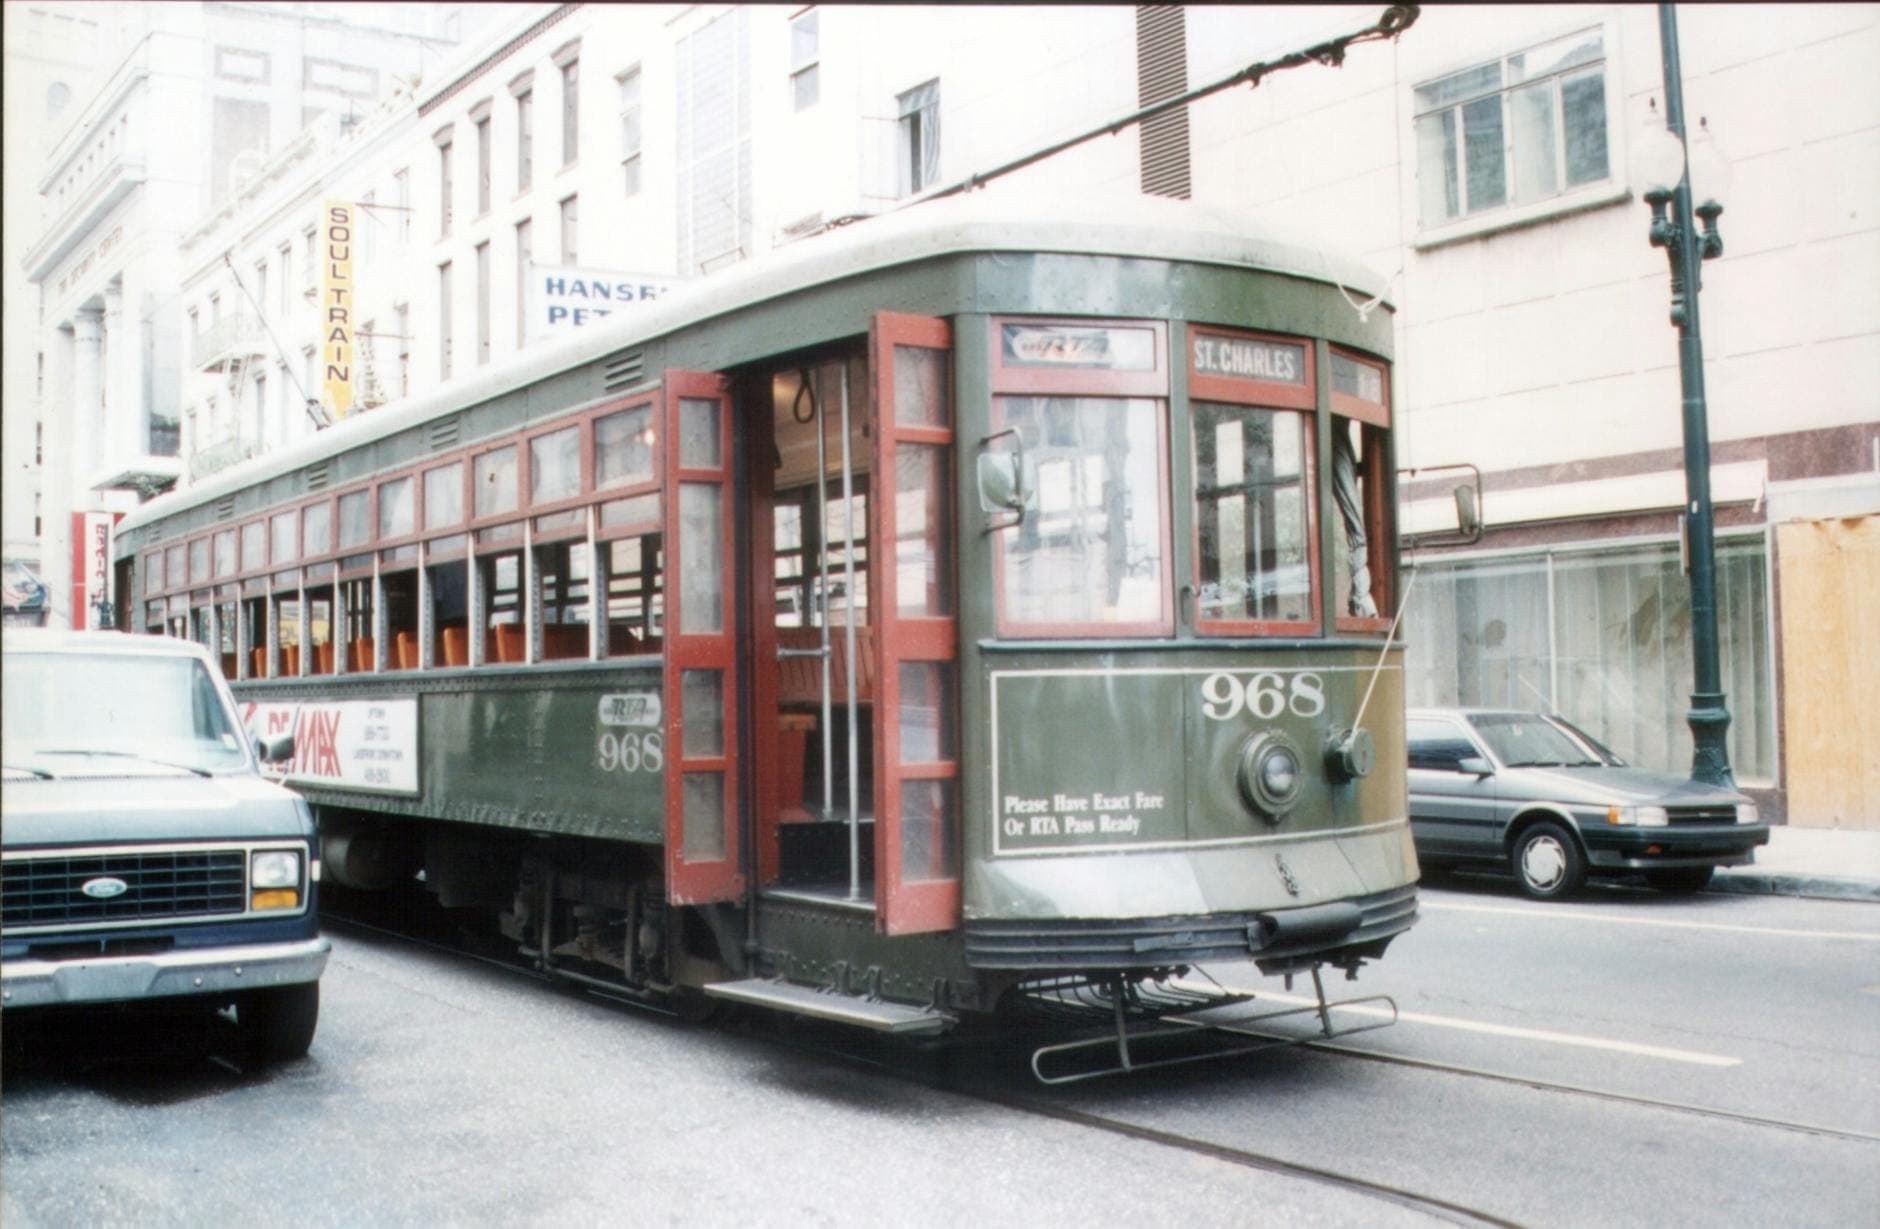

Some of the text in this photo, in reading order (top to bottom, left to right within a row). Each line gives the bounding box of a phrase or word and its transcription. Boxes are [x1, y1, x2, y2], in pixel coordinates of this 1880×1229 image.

[327, 207, 350, 382] SOUL TRAIN
[1194, 339, 1295, 380] ST. CHARLES
[1201, 672, 1326, 720] 968
[598, 731, 664, 773] 968
[1004, 791, 1165, 814] Please Have Exact Fare
[1004, 813, 1141, 836] Or RTA Pass Ready
